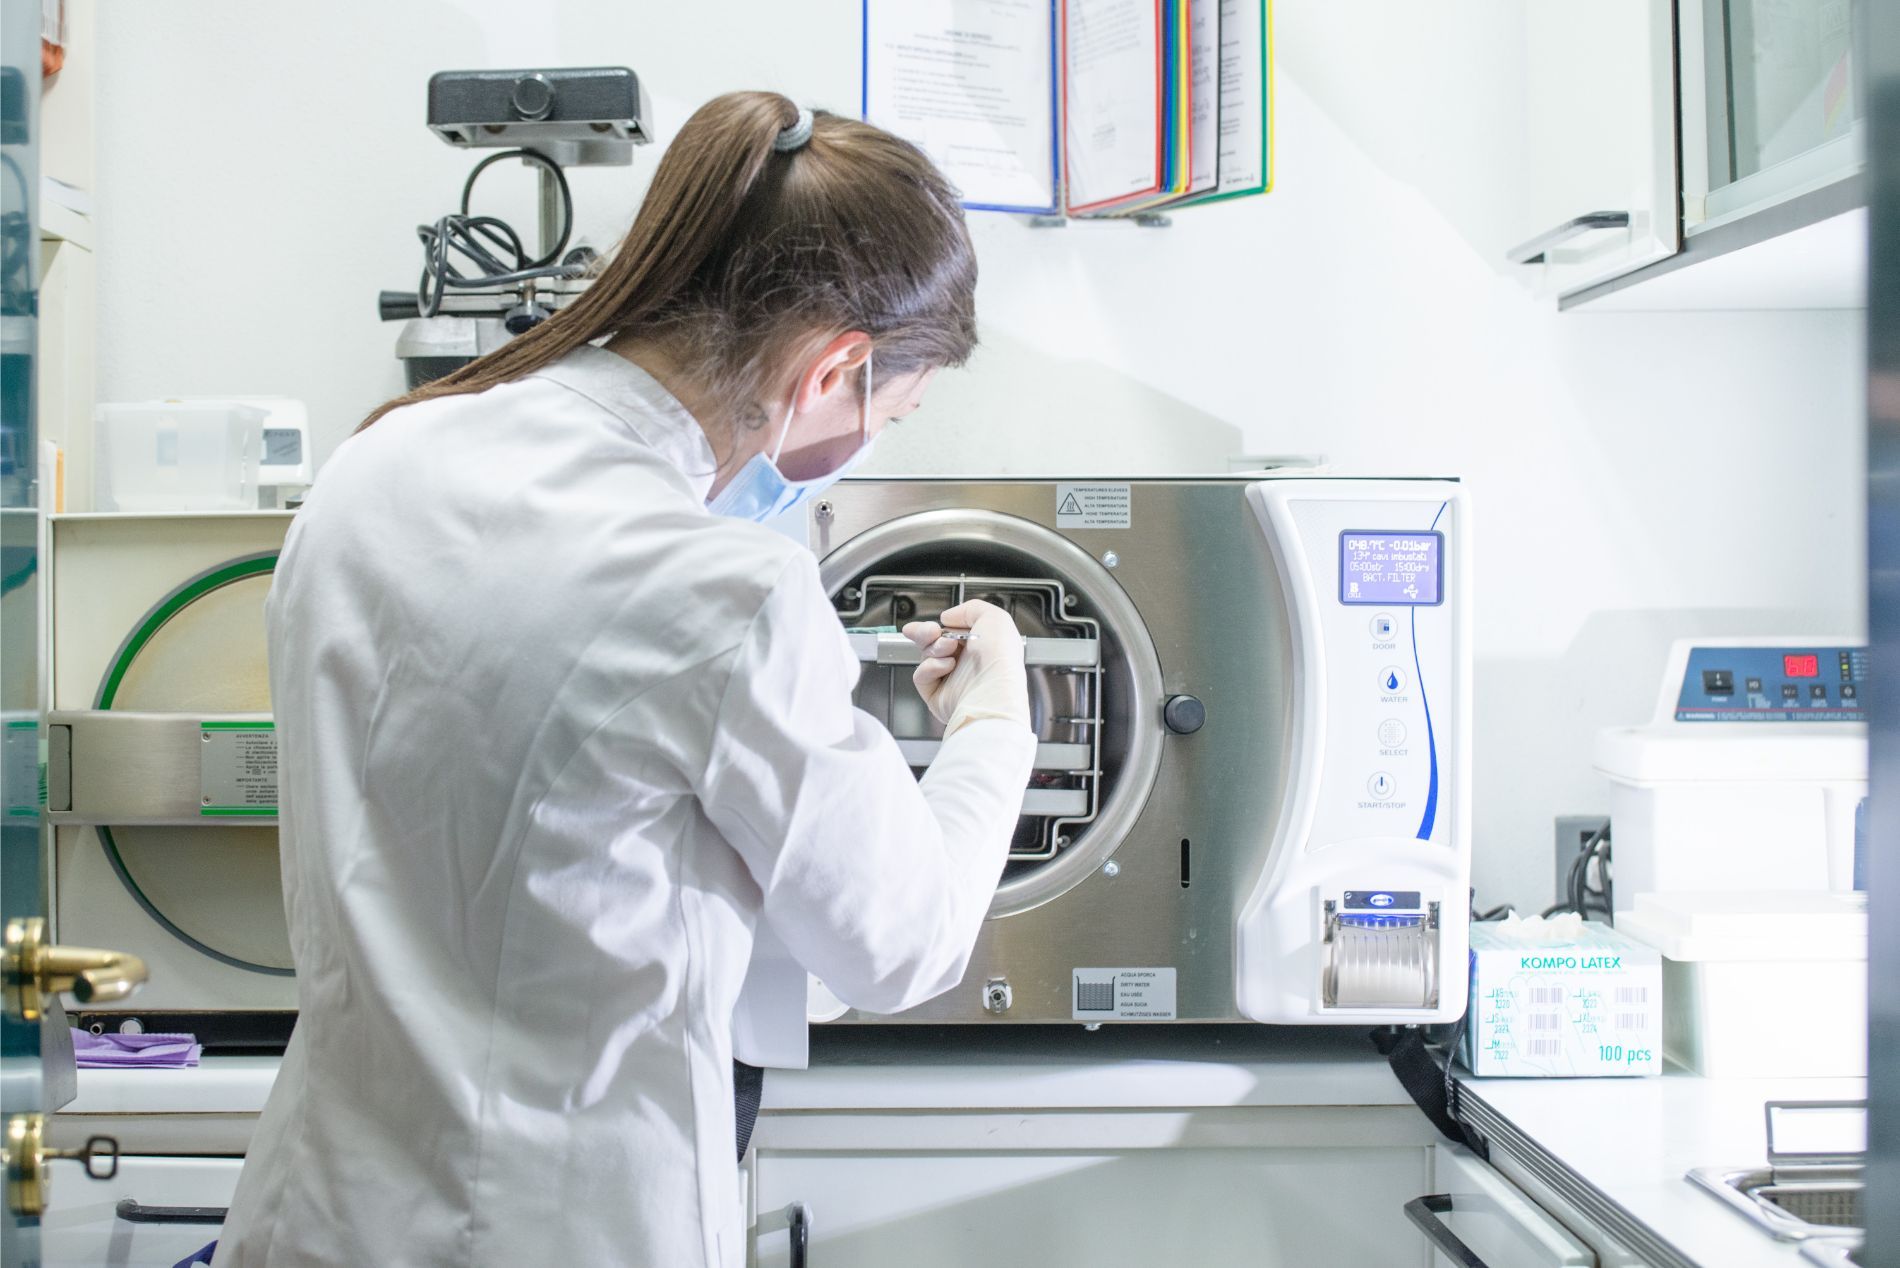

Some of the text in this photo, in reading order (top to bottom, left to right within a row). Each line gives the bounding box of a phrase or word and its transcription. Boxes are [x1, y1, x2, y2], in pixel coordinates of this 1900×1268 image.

[1521, 957, 1621, 969] KOMPO LATEX
[1599, 1045, 1652, 1065] 100 pcs
